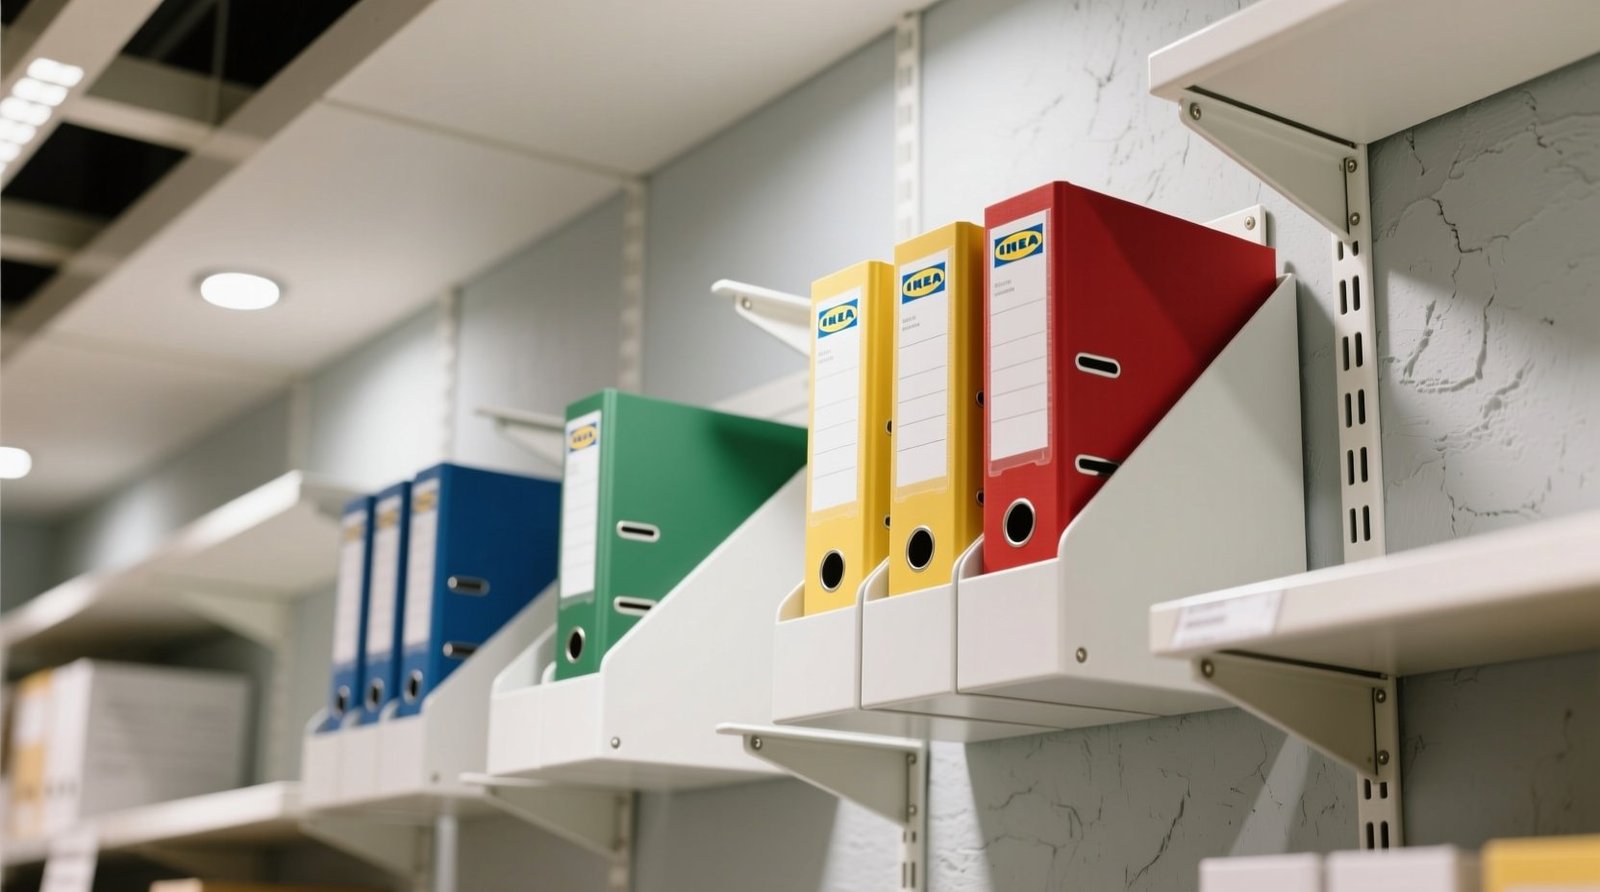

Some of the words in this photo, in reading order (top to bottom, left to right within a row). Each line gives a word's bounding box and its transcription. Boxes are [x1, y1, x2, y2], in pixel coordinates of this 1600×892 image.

[999, 234, 1039, 255] IKEA
[906, 272, 942, 292] IKEA
[822, 309, 855, 327] IKEA
